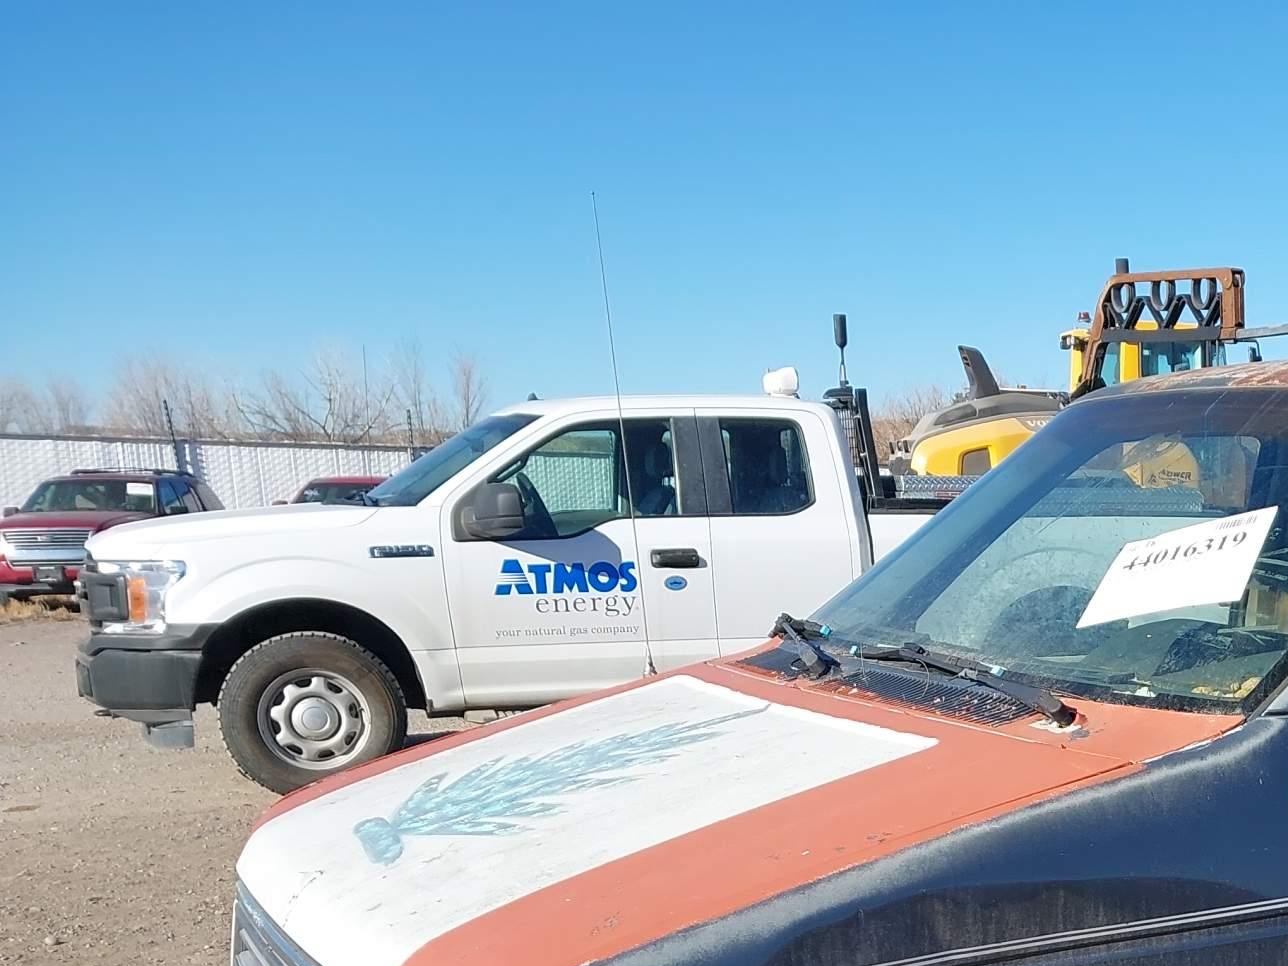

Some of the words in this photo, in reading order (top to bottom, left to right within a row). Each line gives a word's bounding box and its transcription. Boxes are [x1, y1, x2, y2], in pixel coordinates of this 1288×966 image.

[1123, 531, 1248, 571] 44016319
[495, 559, 638, 596] ATMOS
[535, 595, 637, 617] energy
[496, 628, 522, 639] your
[525, 626, 566, 637] natural
[569, 627, 588, 637] gas
[591, 624, 640, 635] company
